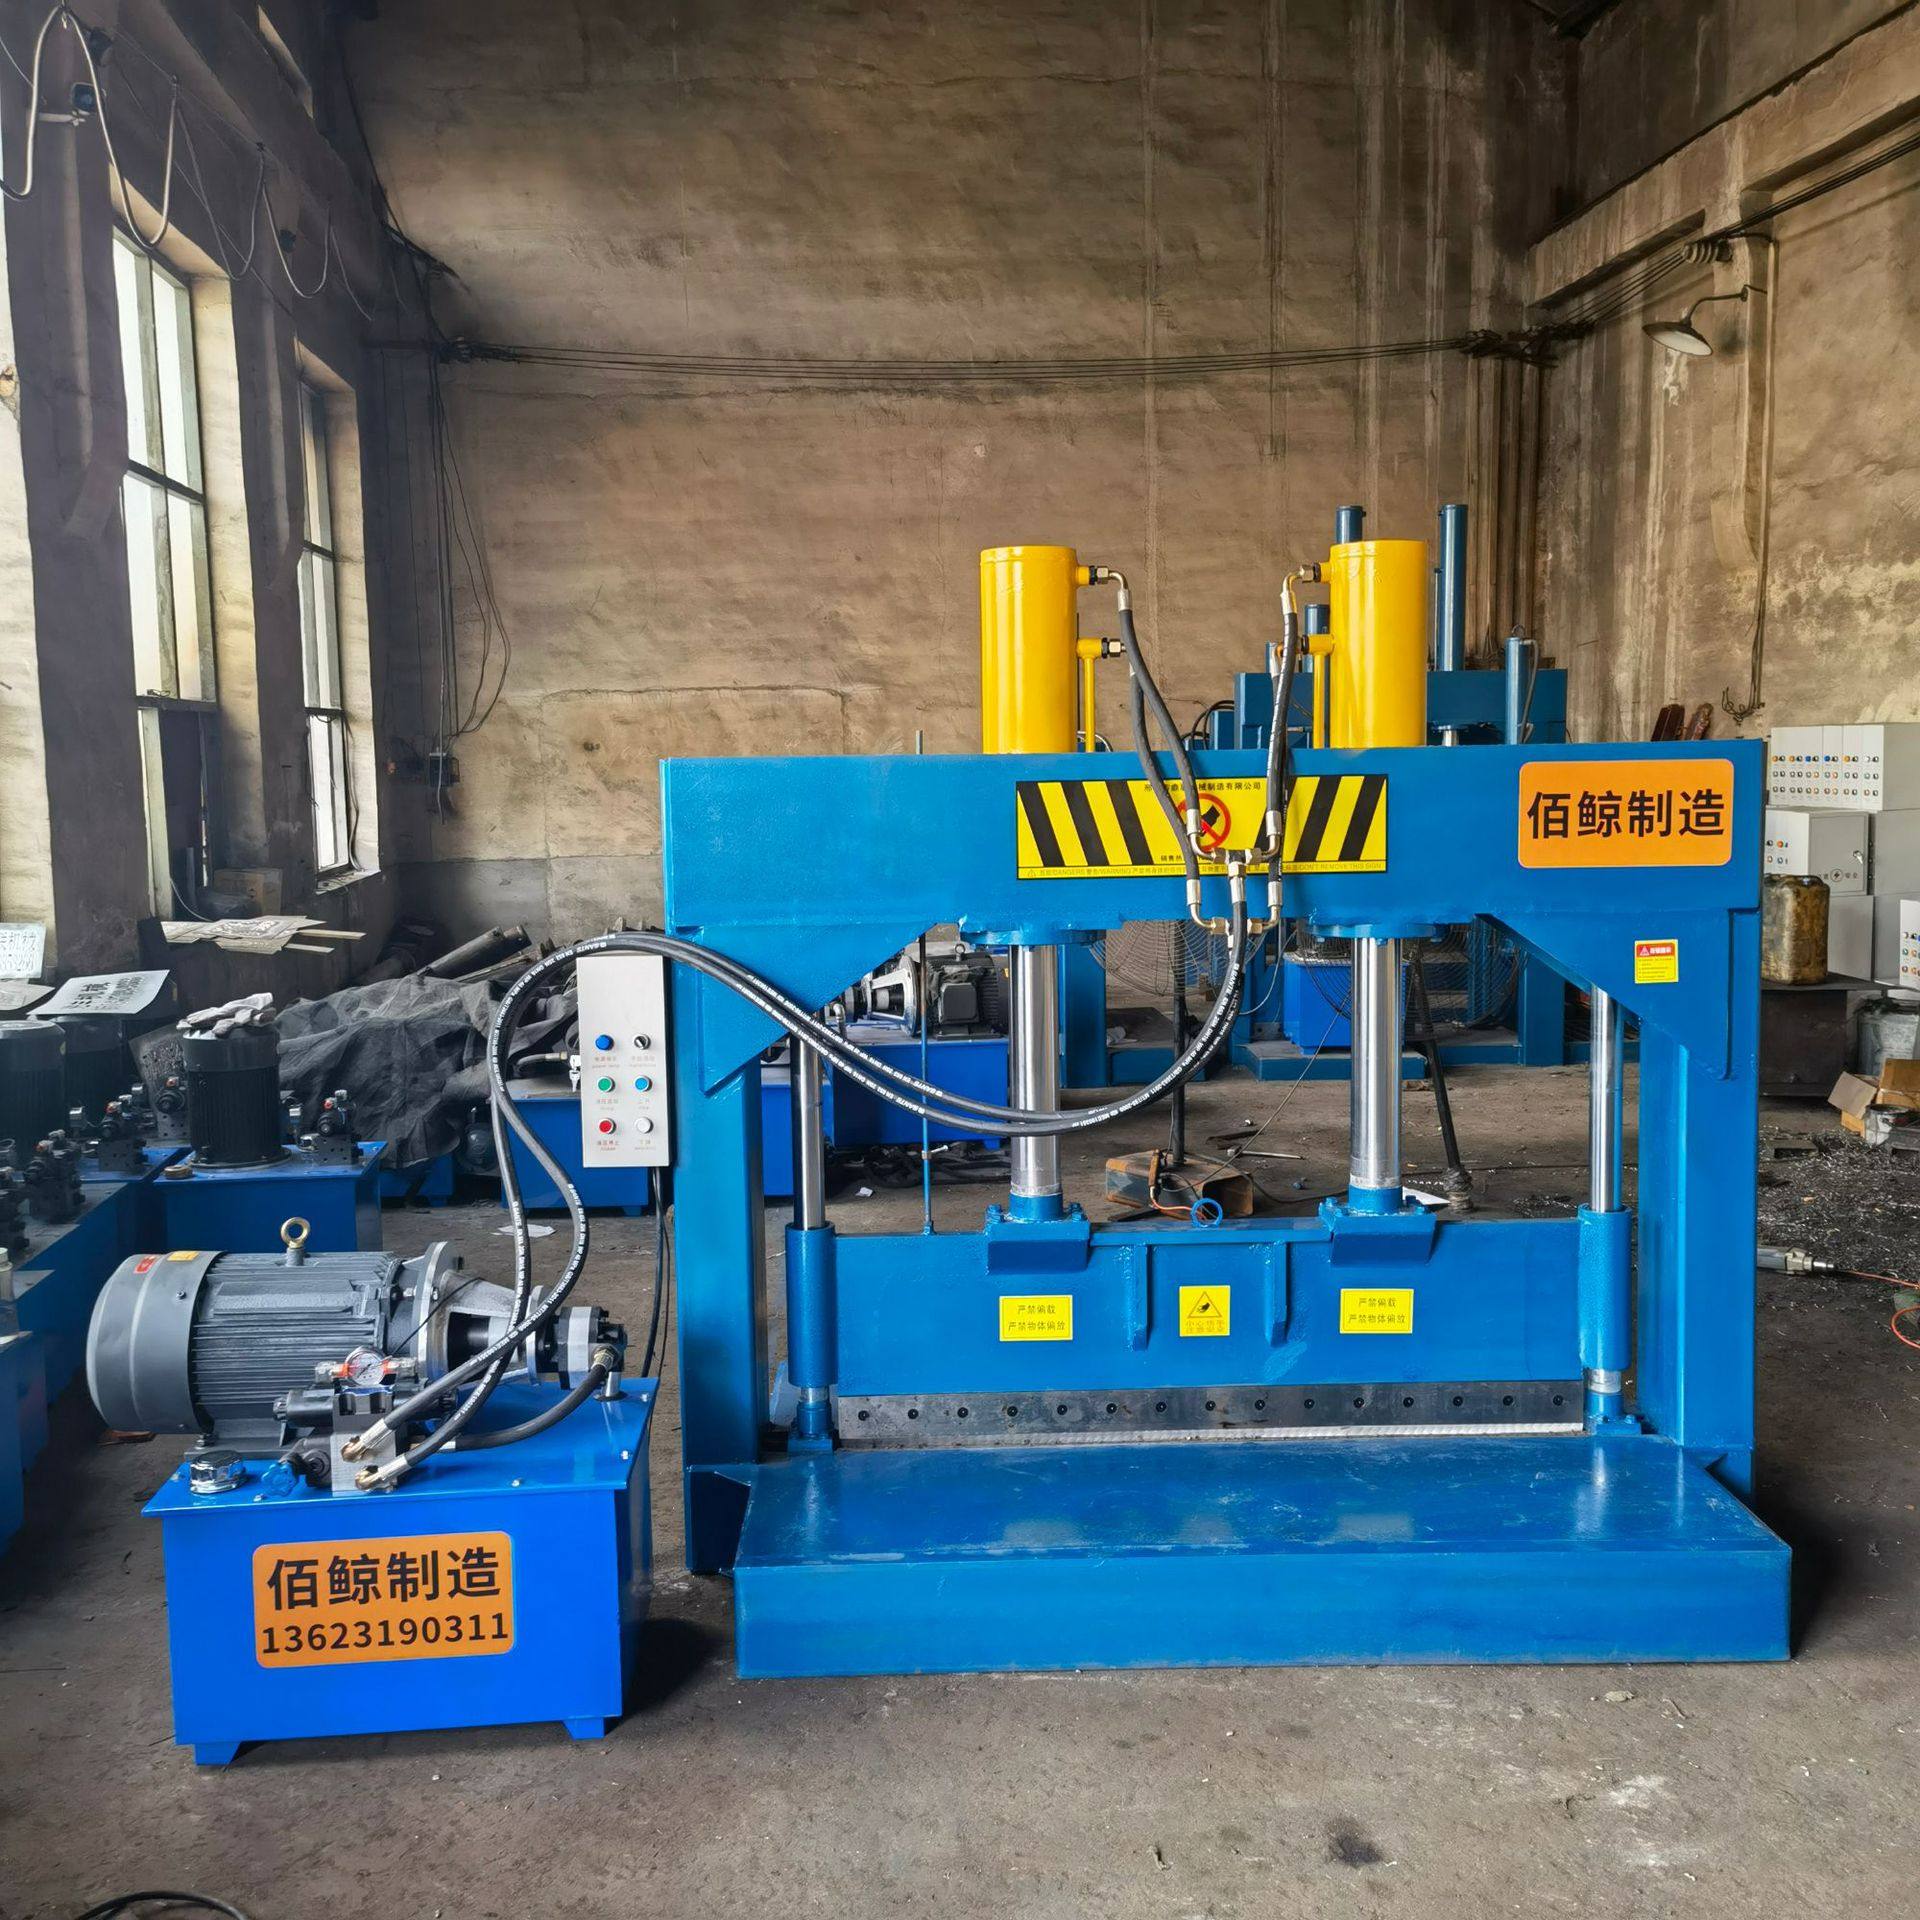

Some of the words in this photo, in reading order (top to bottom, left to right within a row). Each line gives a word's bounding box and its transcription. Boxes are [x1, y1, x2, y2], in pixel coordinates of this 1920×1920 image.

[1527, 788, 1725, 840] 佰鲸制造
[267, 1546, 501, 1611] 佰鲸制造
[262, 1612, 509, 1654] 13623190311
